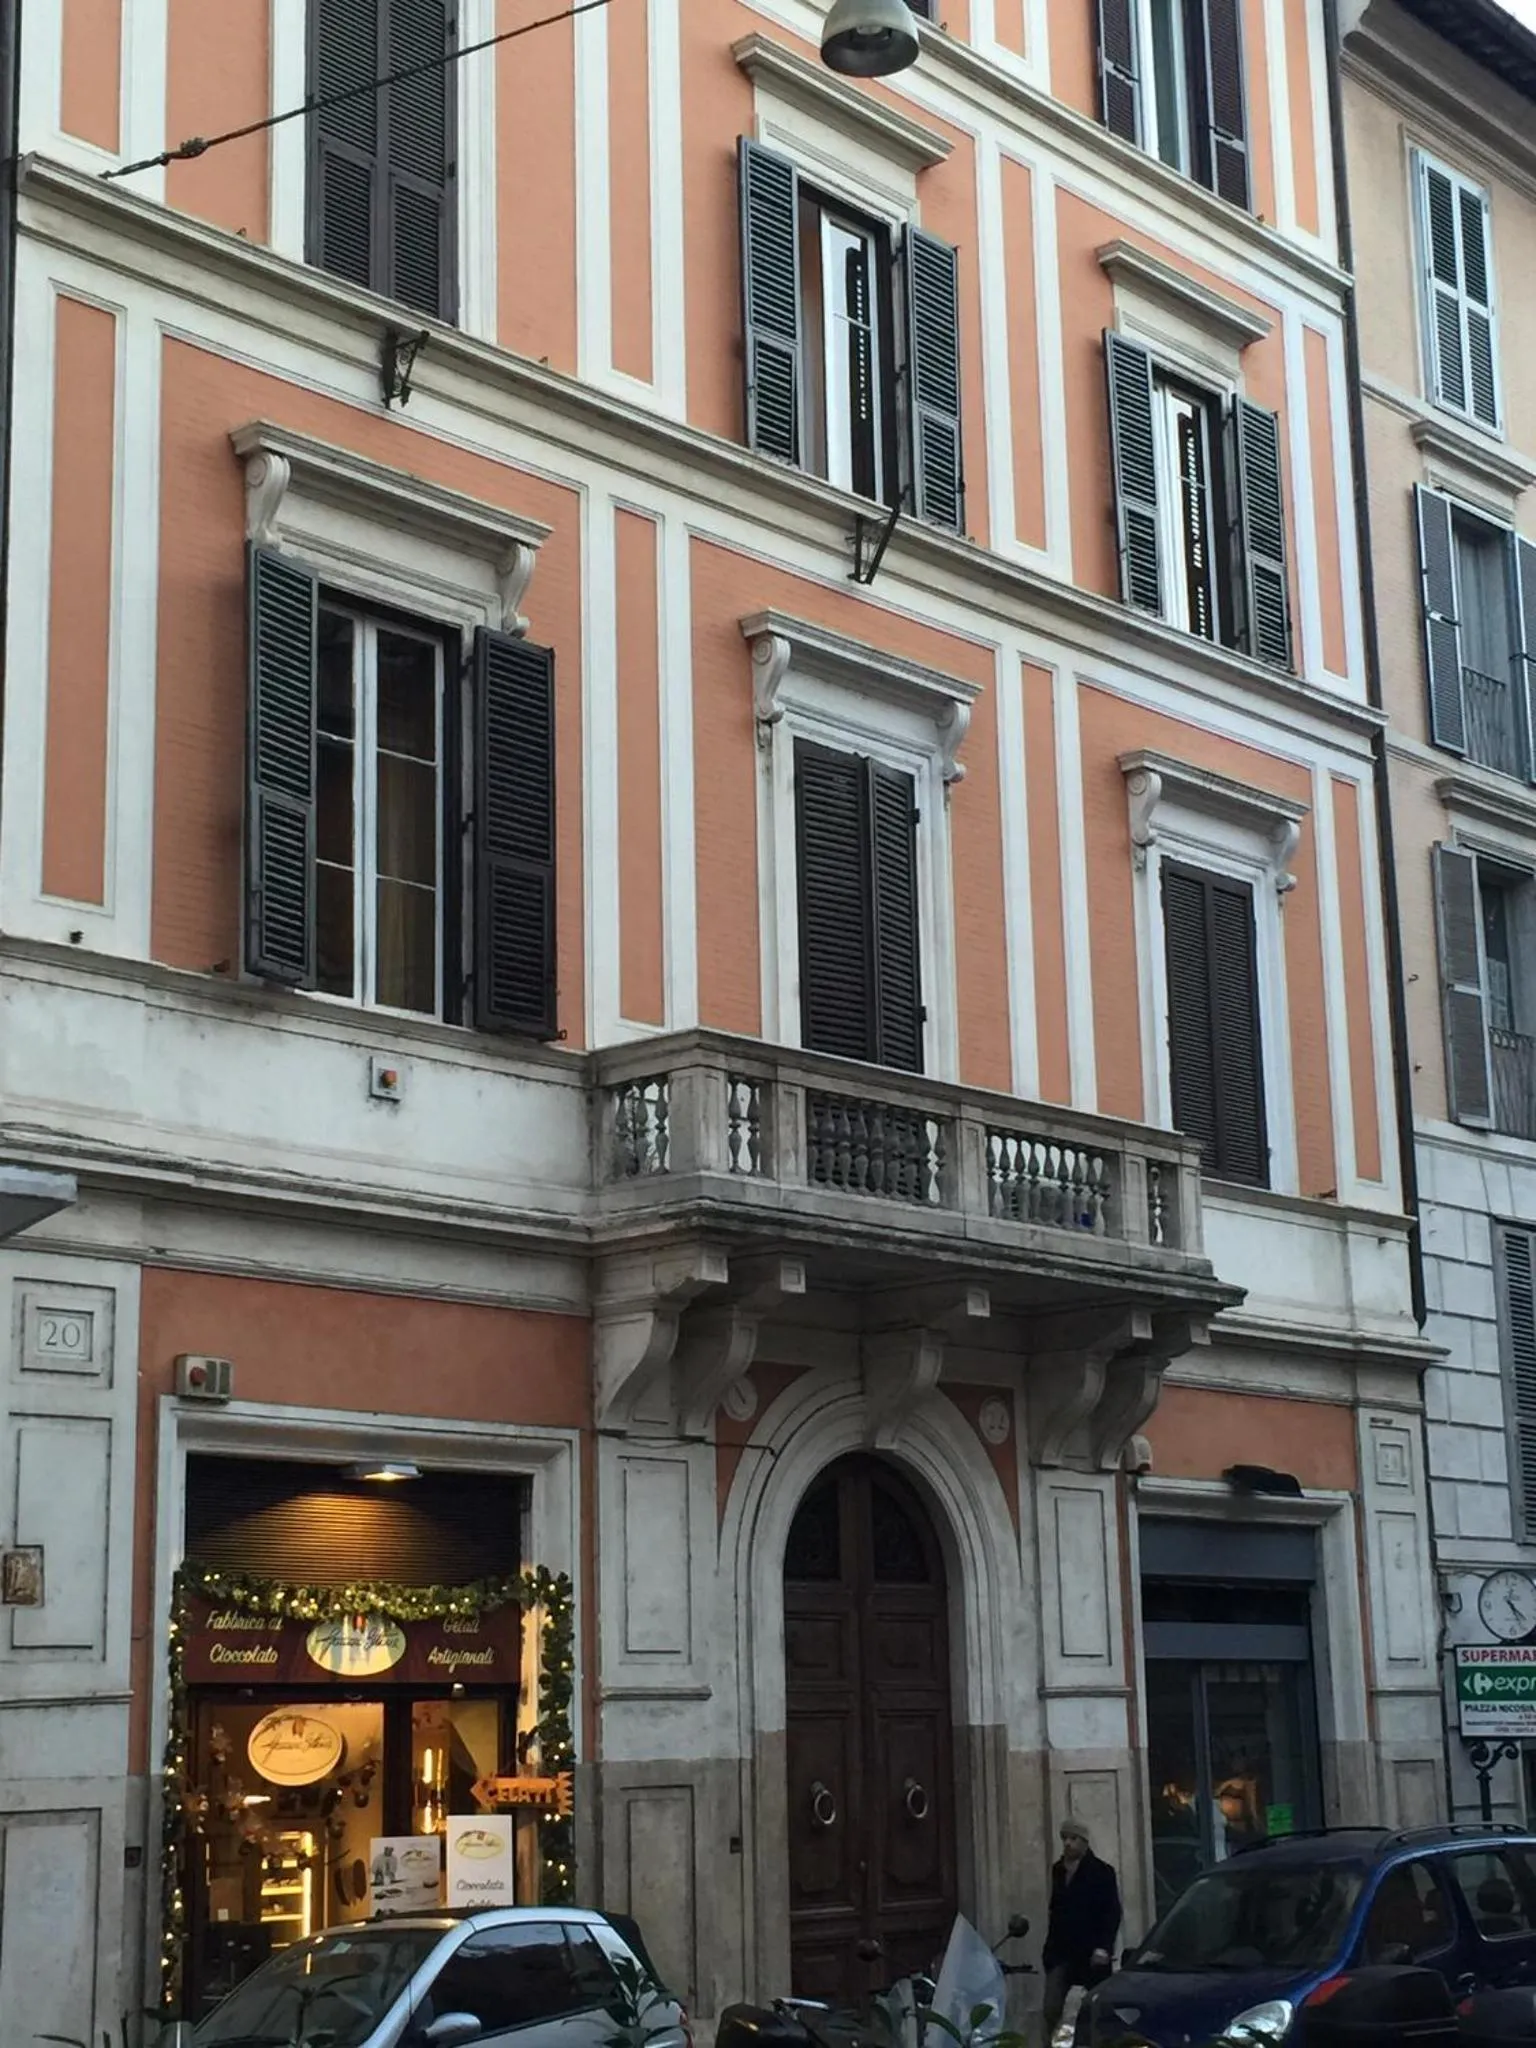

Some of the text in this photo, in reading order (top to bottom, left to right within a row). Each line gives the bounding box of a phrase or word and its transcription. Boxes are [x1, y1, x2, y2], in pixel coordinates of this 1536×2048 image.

[43, 1320, 80, 1347] 20
[205, 1609, 266, 1631] Fabbrica
[209, 1643, 279, 1664] Cioccolato
[427, 1645, 495, 1675] Artigianali
[484, 1785, 553, 1804] GELATI
